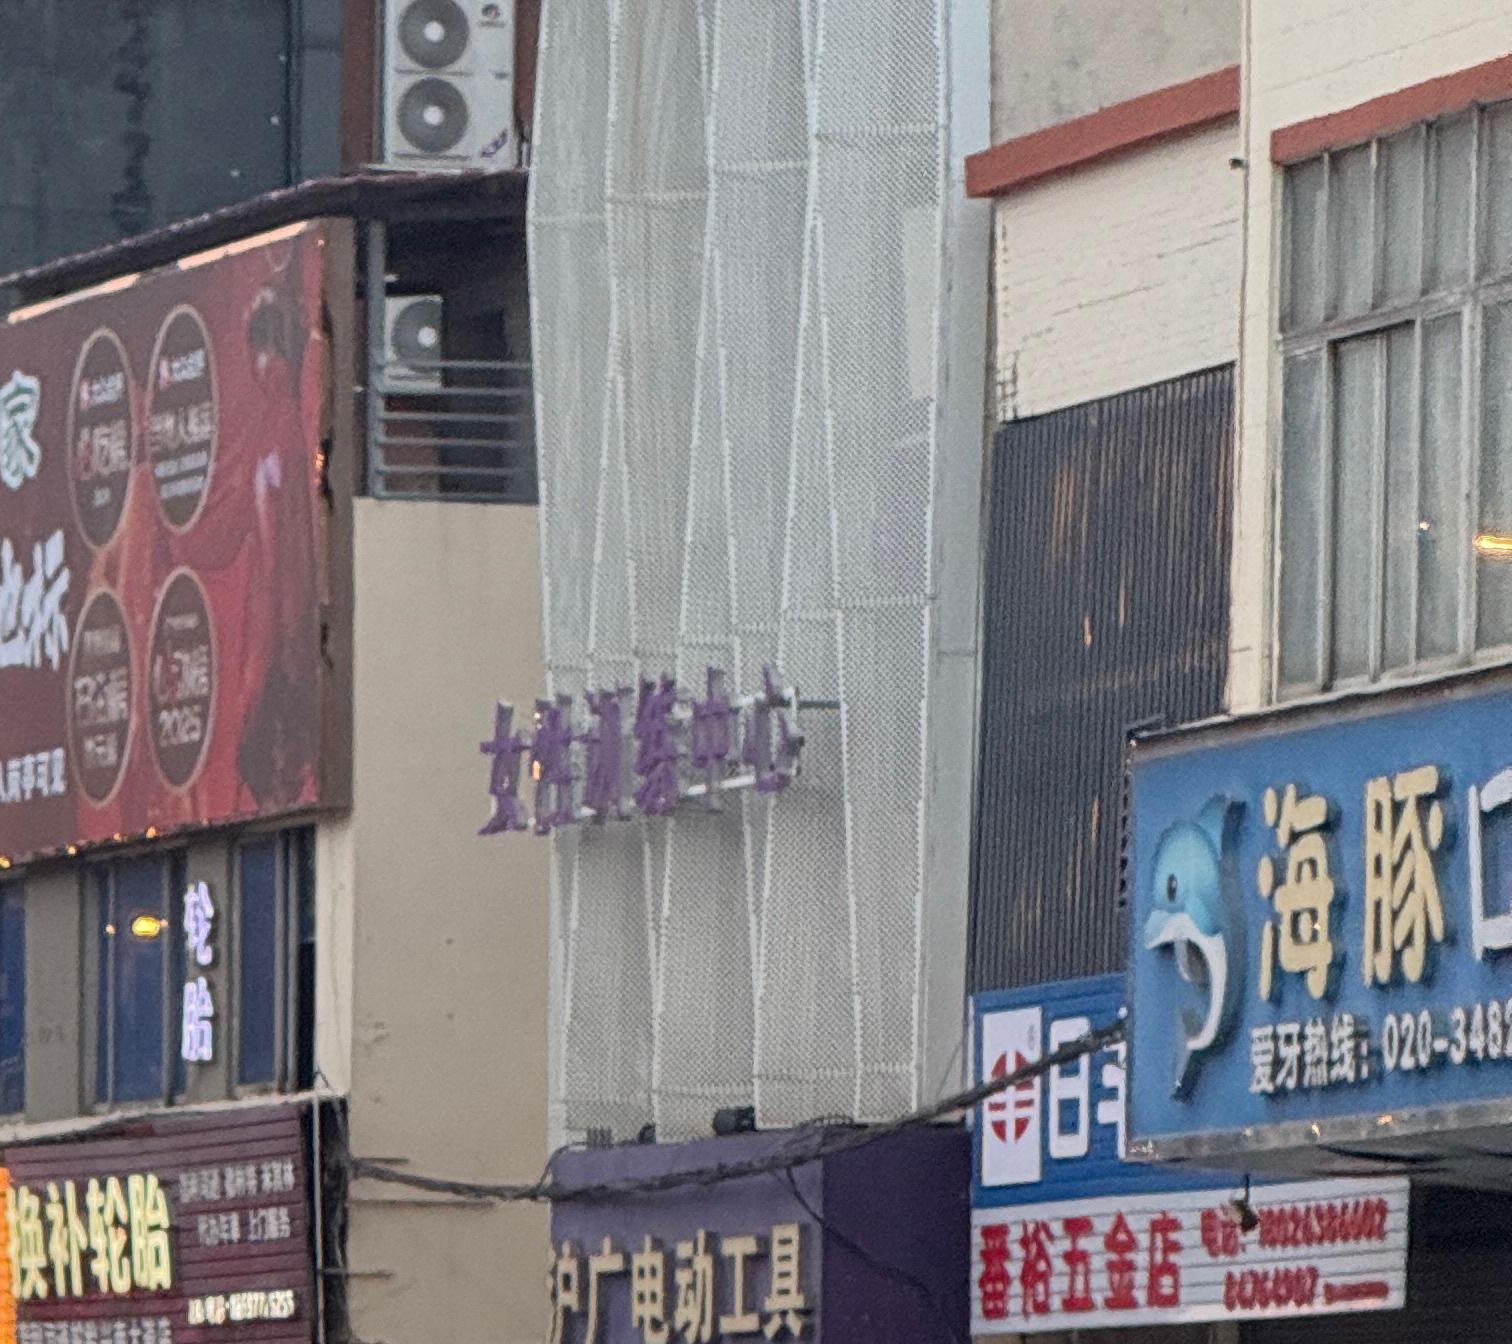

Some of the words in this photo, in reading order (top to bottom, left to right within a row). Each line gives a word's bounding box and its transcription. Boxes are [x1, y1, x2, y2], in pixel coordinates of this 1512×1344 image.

[182, 881, 215, 1061] 轮胎
[7, 1174, 172, 1301] 换补轮胎
[978, 1210, 1182, 1319] 番裕五金店
